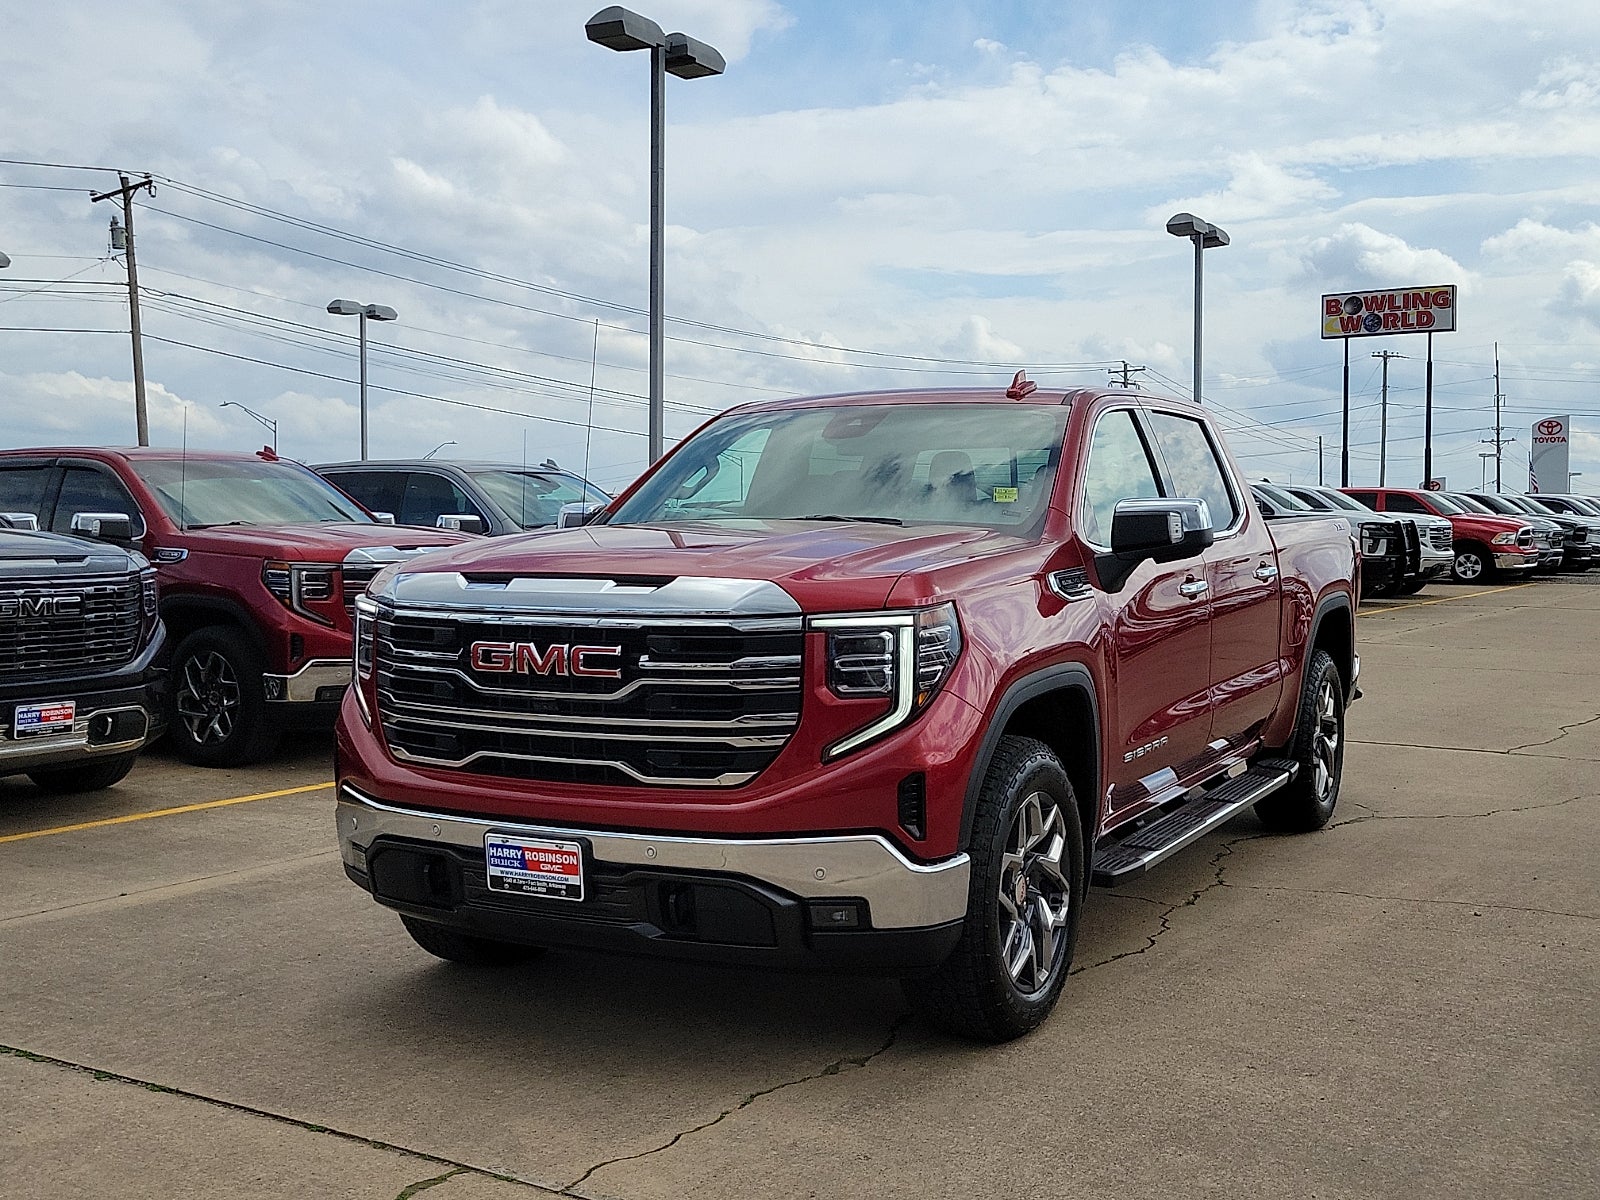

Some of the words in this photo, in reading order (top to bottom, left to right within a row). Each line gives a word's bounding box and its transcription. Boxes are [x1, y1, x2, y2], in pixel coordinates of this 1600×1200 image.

[1325, 290, 1450, 316] BOWLING
[1339, 310, 1435, 333] WORLD
[1532, 436, 1567, 444] TOYOTA
[0, 596, 81, 618] GMC
[470, 640, 622, 679] GMC
[18, 711, 40, 719] HARRY
[41, 708, 73, 718] ROBINSON
[1123, 735, 1169, 763] SIERRA
[489, 846, 522, 859] HARRY
[524, 850, 578, 866] ROBINSON
[490, 857, 522, 868] BUICK
[540, 863, 564, 872] GMC
[500, 869, 570, 883] WWW.HARRYROBINSON.COM
